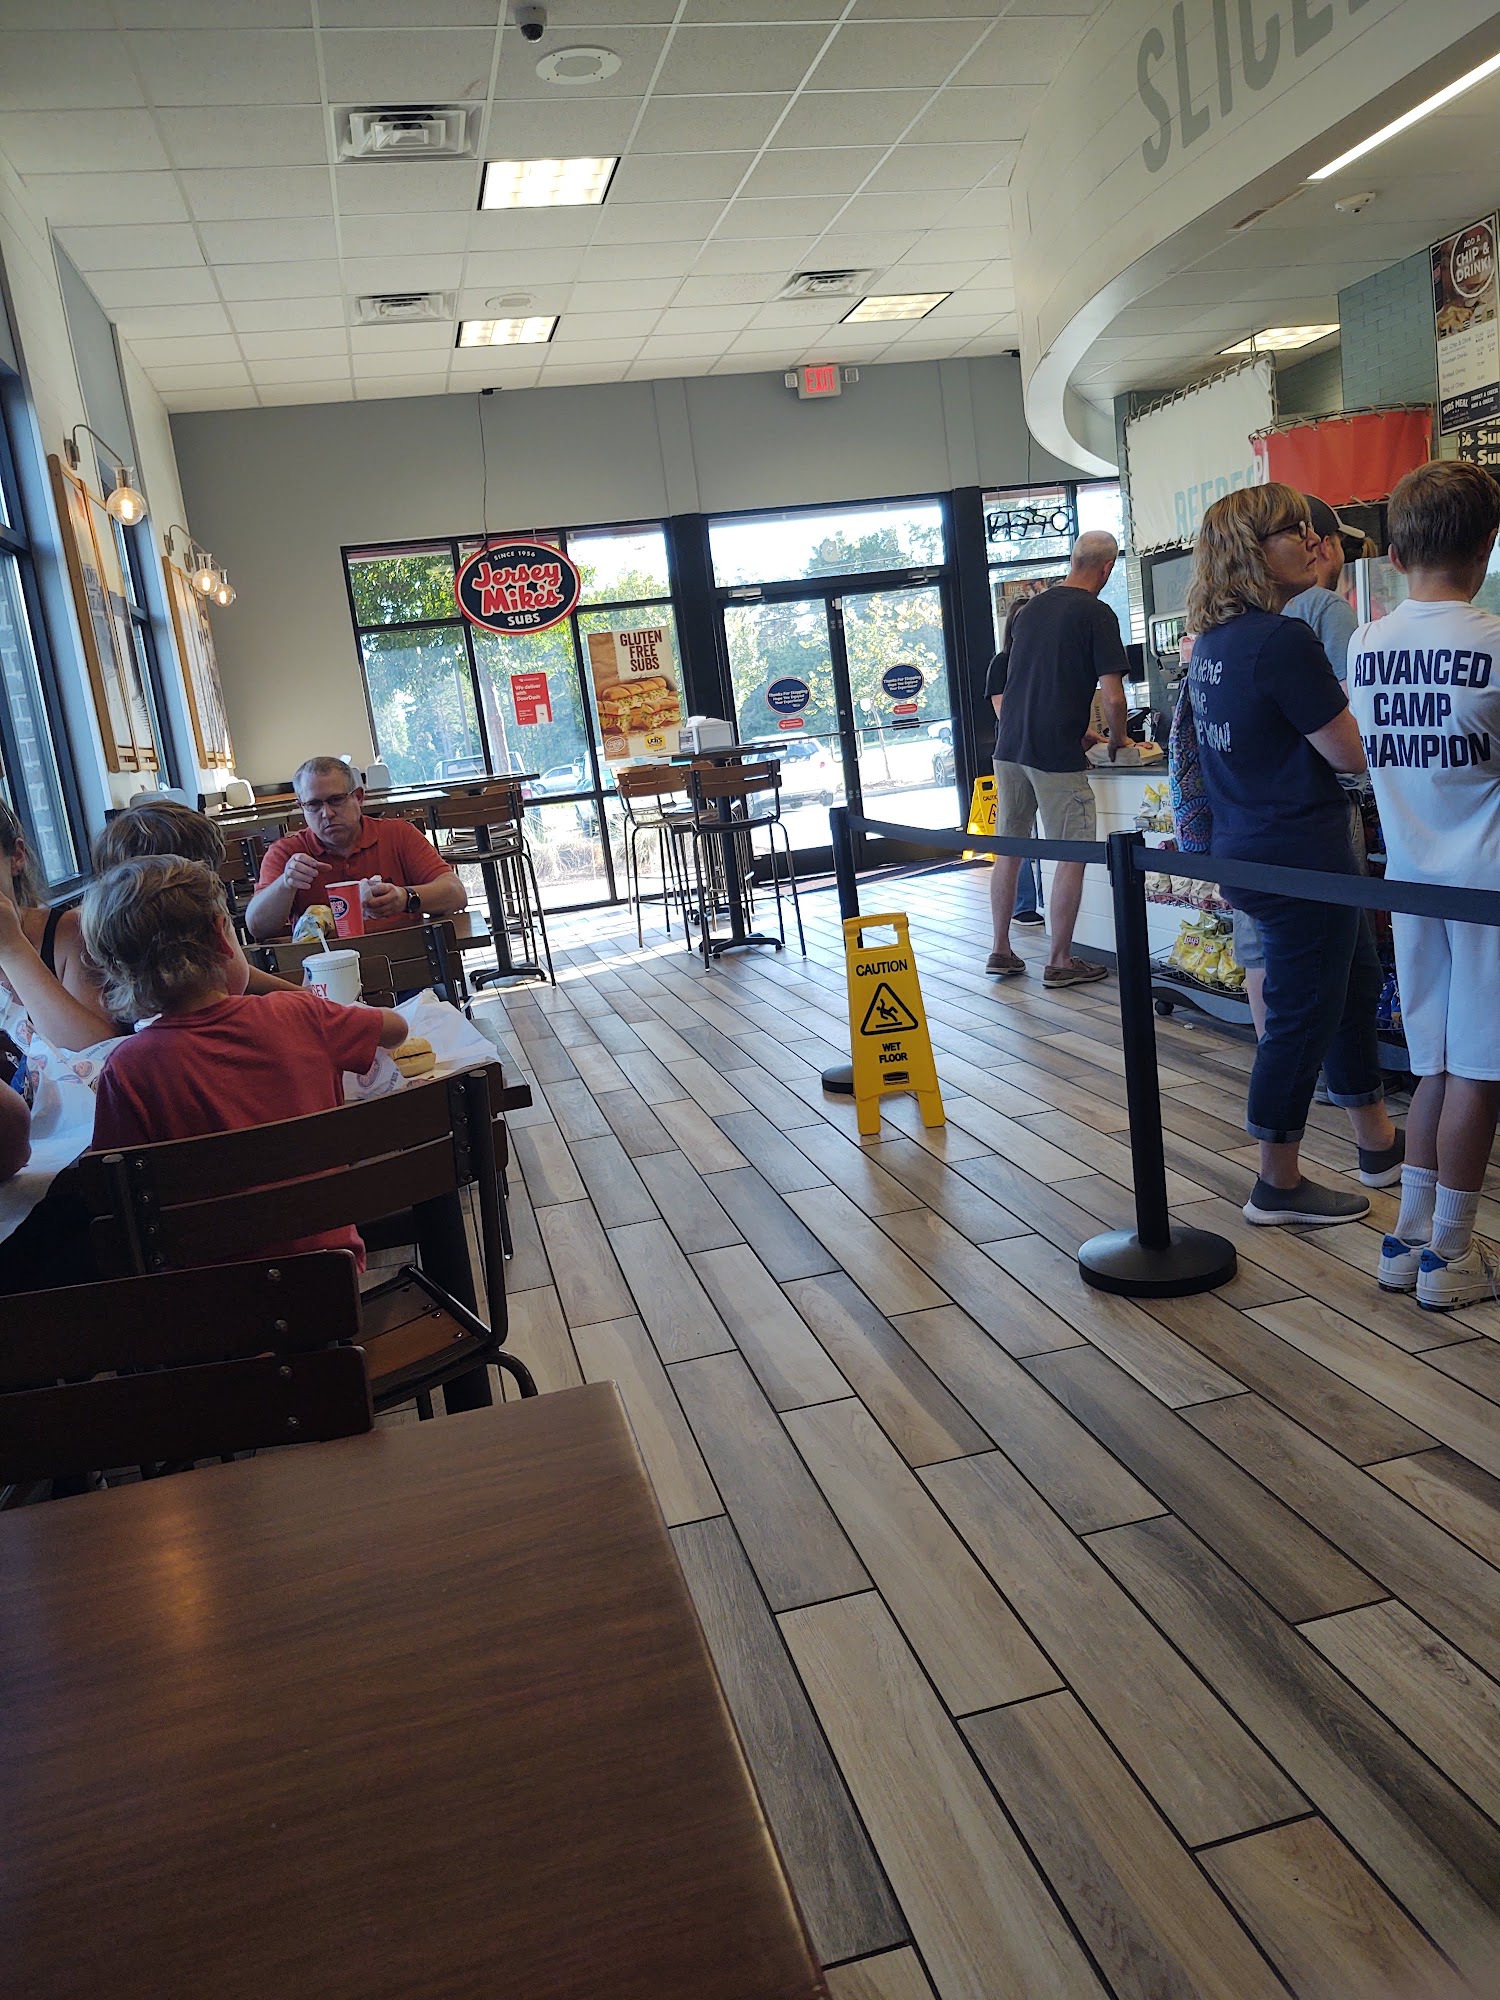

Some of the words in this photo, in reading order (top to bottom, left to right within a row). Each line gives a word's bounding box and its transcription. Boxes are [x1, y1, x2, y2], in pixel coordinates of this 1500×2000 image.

[1463, 238, 1475, 248] ADD
[1476, 234, 1481, 242] A
[1456, 246, 1479, 267] CHIP
[1482, 242, 1490, 255] &
[1456, 255, 1491, 283] DRINK!
[805, 366, 835, 394] EXIT
[1443, 401, 1454, 414] KIDS
[1455, 398, 1468, 408] MEAL
[494, 552, 514, 561] SINCE
[472, 562, 562, 589] Jersey
[482, 584, 563, 615] Mike's
[507, 613, 540, 626] SUBS
[620, 630, 662, 646] GLUTEN
[630, 644, 657, 658] FREE
[630, 657, 659, 672] SUBS
[1354, 649, 1492, 688] ADVANCED
[1374, 692, 1452, 727] CAMP
[856, 959, 908, 976] CAUTION
[882, 1042, 901, 1052] WET
[879, 1052, 908, 1063] FLOOR
